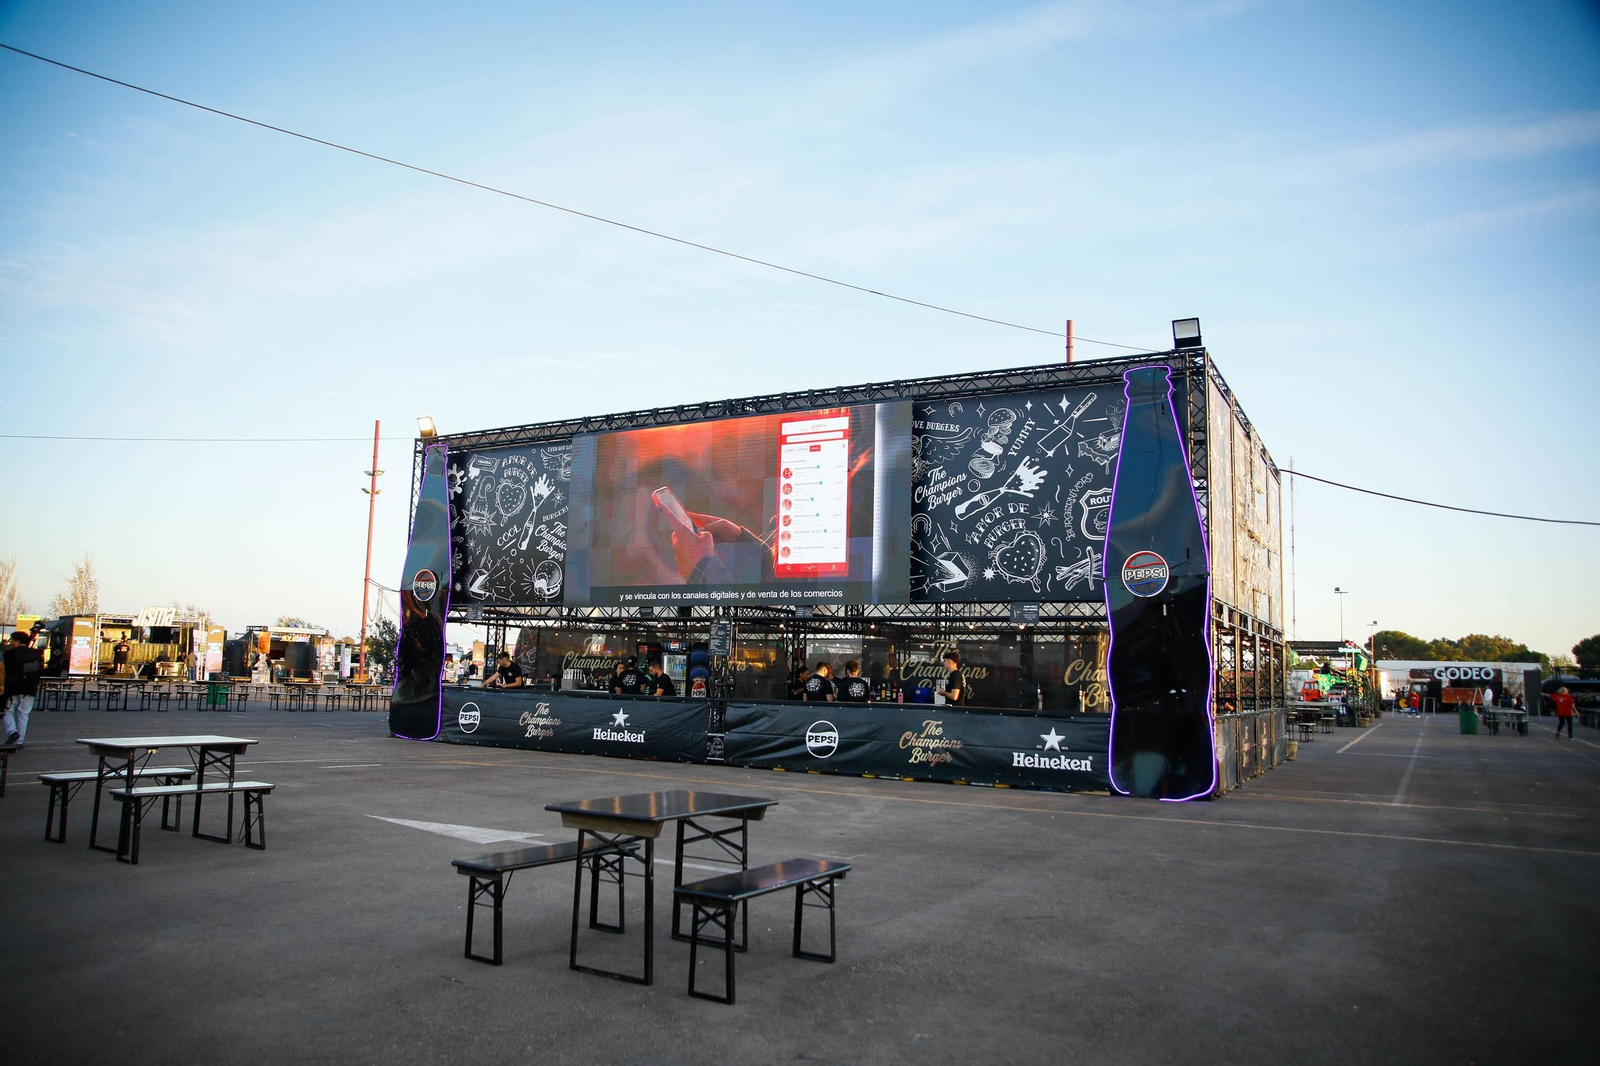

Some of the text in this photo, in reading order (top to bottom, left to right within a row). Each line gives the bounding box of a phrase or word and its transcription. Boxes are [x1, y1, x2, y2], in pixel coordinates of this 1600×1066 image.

[926, 421, 960, 433] BURGERS
[1008, 417, 1036, 456] YUMMY
[502, 455, 538, 479] AMOR DE
[503, 467, 530, 482] BURGER
[928, 465, 947, 487] The
[915, 473, 967, 504] Champions
[927, 486, 963, 511] Burger
[550, 521, 568, 538] The
[971, 502, 1030, 545] AMOR DE
[497, 524, 522, 547] COOL
[983, 518, 1027, 549] BURGER
[536, 539, 565, 562] Burger
[1125, 567, 1167, 580] PEPSI
[619, 593, 624, 602] y
[634, 592, 657, 600] vincula
[671, 592, 682, 600] los
[682, 591, 709, 600] canales
[710, 590, 740, 601] digitales
[740, 591, 746, 600] y
[746, 590, 756, 599] de
[758, 591, 778, 599] venta
[779, 589, 789, 598] de
[790, 589, 802, 598] los
[803, 588, 843, 598] comercios
[1433, 667, 1494, 680] GODEO
[460, 713, 479, 721] PEPSI
[518, 711, 562, 727] Champions
[534, 702, 550, 717] The
[524, 724, 555, 740] Burger
[592, 728, 646, 743] Heineken
[920, 719, 944, 738] The
[808, 735, 837, 745] PEPSI
[899, 730, 963, 749] Champions
[908, 747, 953, 767] Burger
[1012, 752, 1092, 771] Heineken
